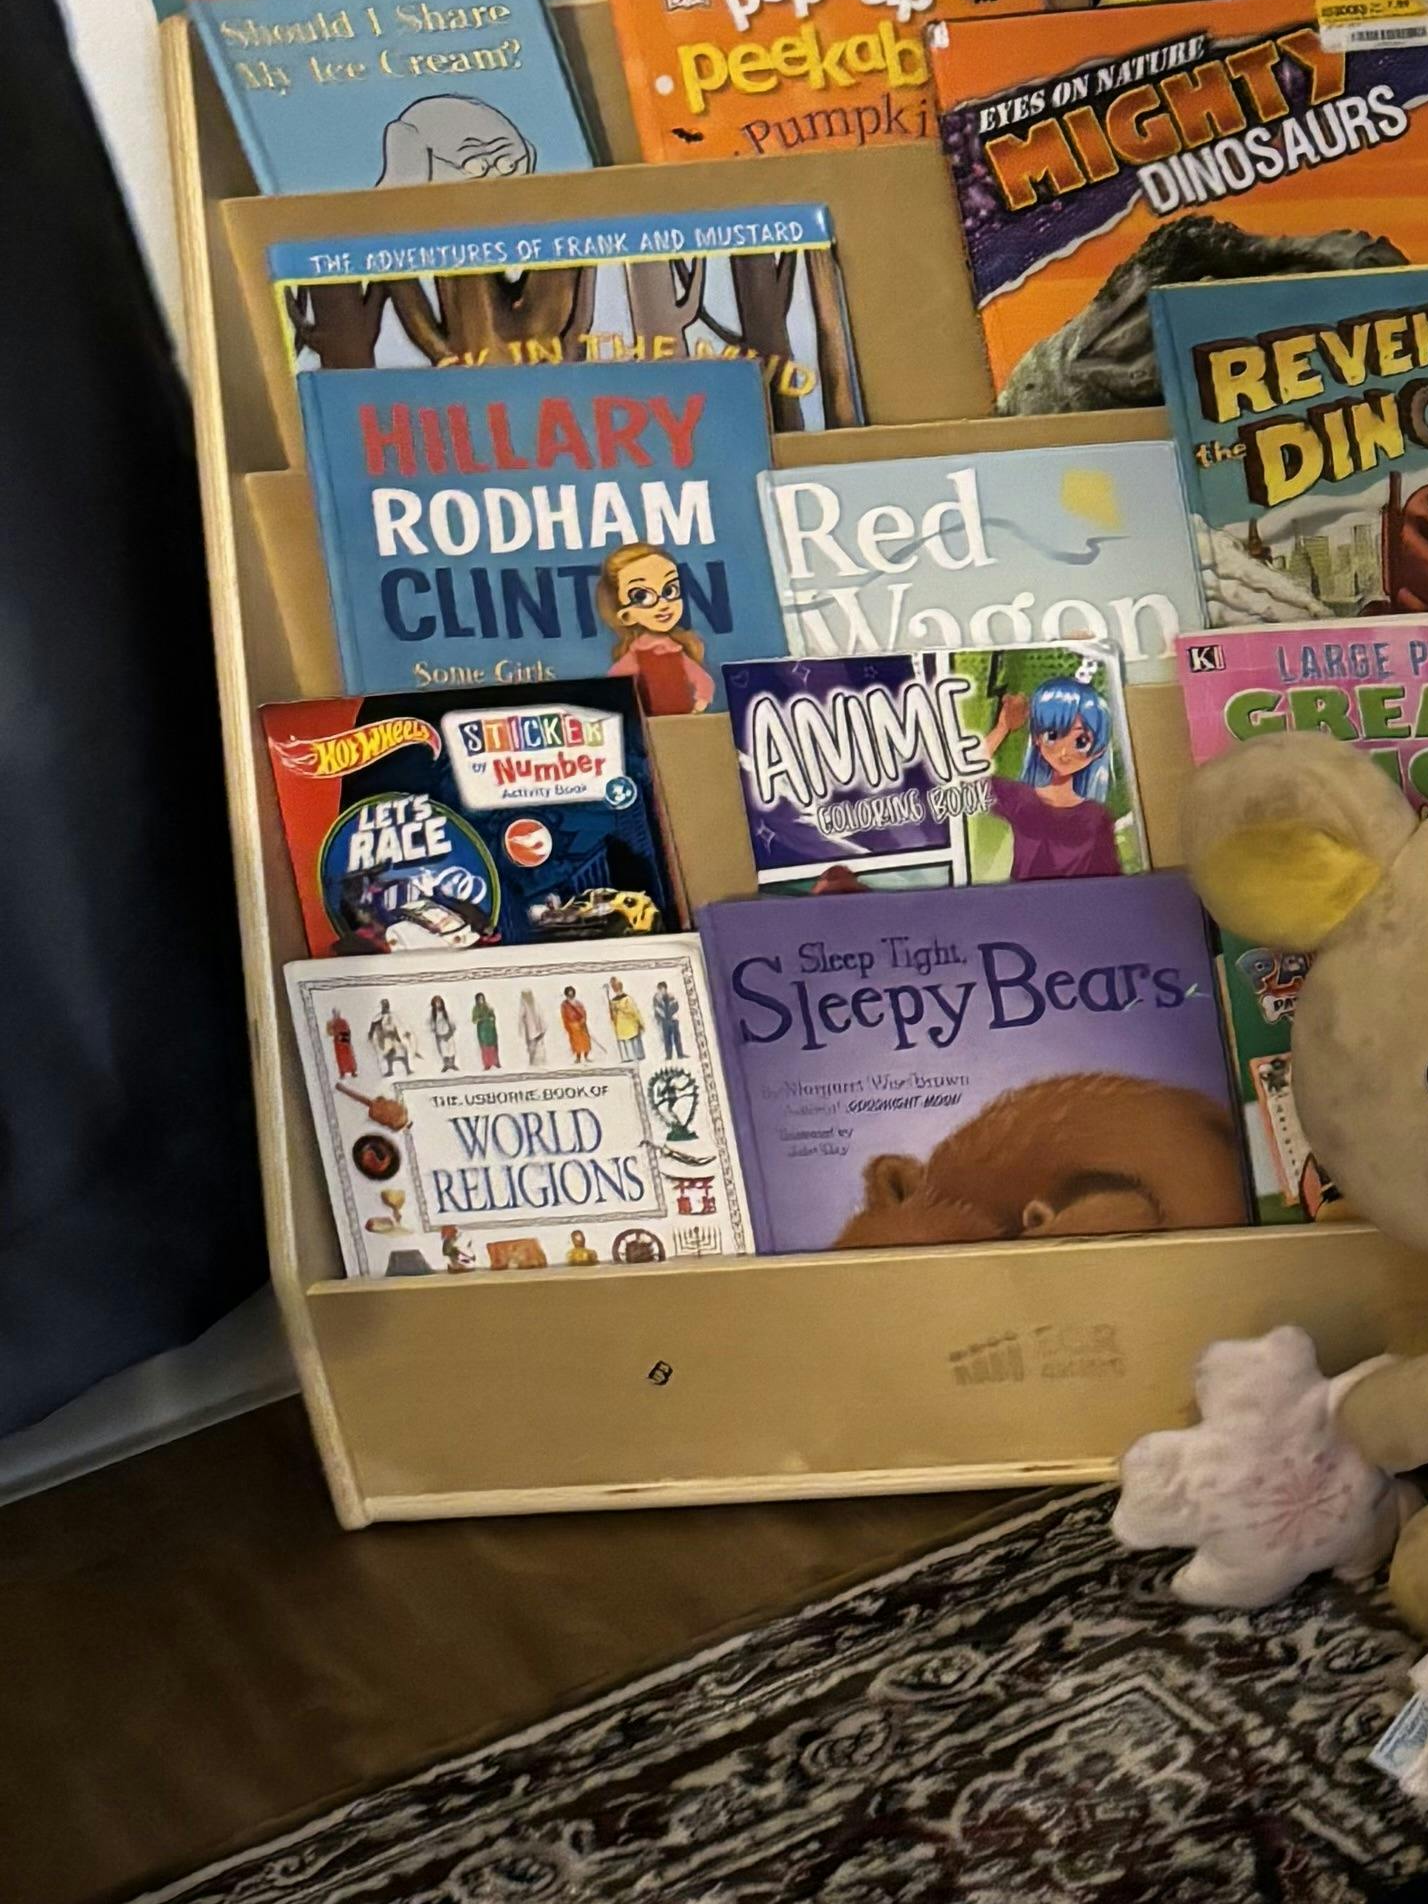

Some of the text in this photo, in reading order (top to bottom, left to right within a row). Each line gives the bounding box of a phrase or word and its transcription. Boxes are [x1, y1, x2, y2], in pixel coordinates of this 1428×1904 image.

[219, 1, 512, 50] Should I Share
[235, 38, 523, 97] My Ice Cream?
[979, 34, 1208, 135] EYES ON NATURE
[984, 28, 1348, 213] MIGHTY
[1136, 84, 1411, 216] DINOSAURS
[310, 220, 805, 275] THE ADVENTURES OF FRANK AND MUSTARD
[358, 393, 708, 478] HILLARY
[1196, 440, 1248, 469] the
[371, 479, 716, 558] RODHAM
[774, 467, 999, 580] Red
[380, 559, 735, 642] CLINTN
[784, 582, 1181, 663] Wagon
[412, 658, 557, 688] Some Girls
[1276, 642, 1396, 684] LARGE
[458, 712, 605, 757] STICKER
[751, 676, 991, 809] ANIME
[493, 751, 608, 787] Number
[358, 794, 433, 830] LET'S
[817, 778, 996, 836] COLORING BOOK
[347, 816, 452, 874] RACE
[798, 935, 969, 979] Sleep Tight,
[731, 940, 1189, 1052] Sleepy Bears
[432, 1083, 609, 1110] THE USBORNE BOOK OF
[448, 1106, 603, 1162] WORLD
[431, 1154, 646, 1215] RELIGIONS
